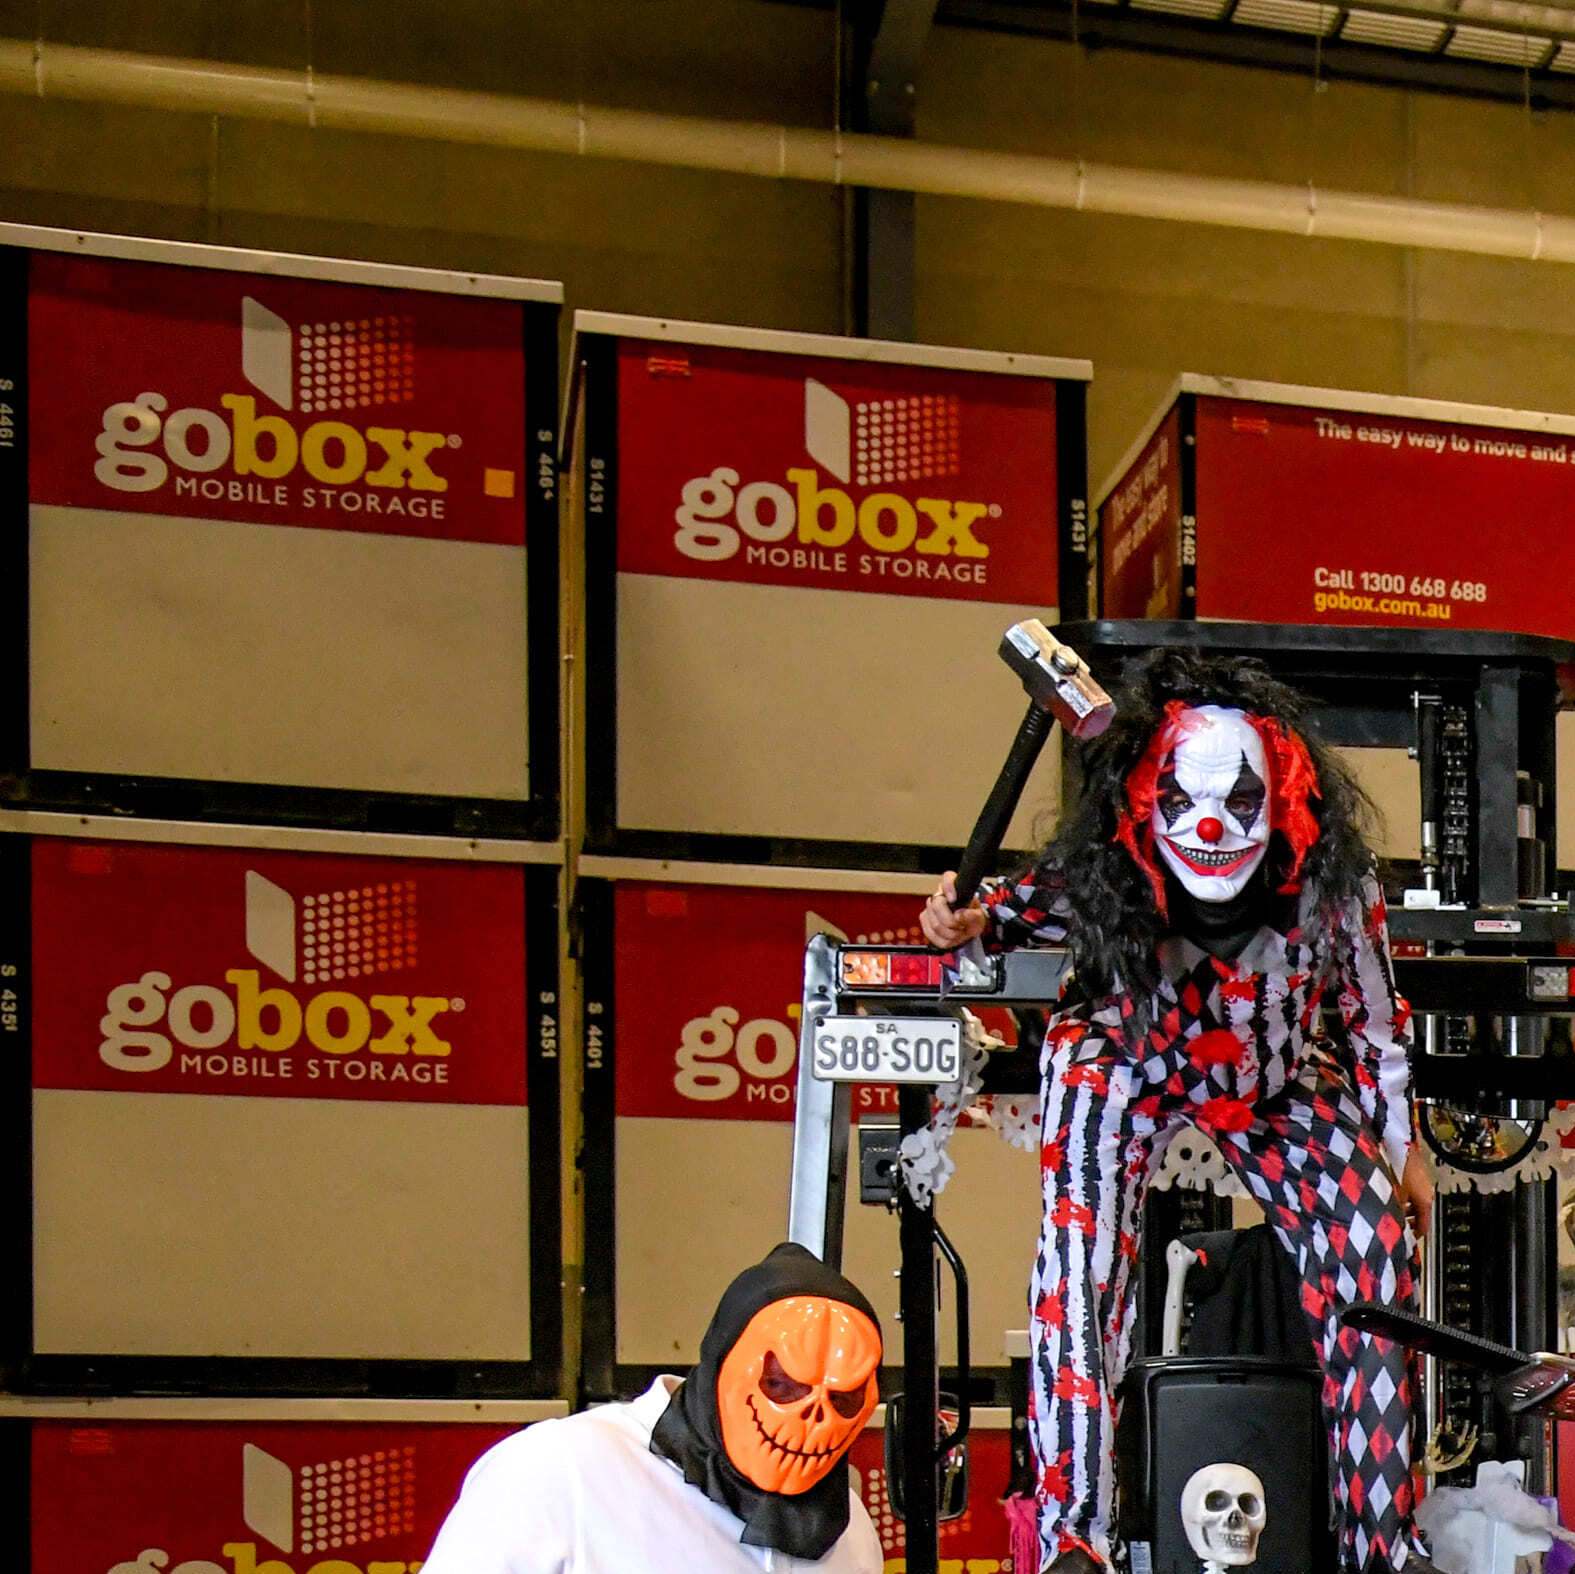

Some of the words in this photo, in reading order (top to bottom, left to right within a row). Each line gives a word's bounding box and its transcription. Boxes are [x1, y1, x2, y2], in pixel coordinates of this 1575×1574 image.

[94, 392, 448, 492] gobox
[1315, 418, 1352, 441] The
[1357, 425, 1403, 449] easy
[1406, 433, 1446, 454] way
[1451, 433, 1470, 454] to
[1474, 438, 1526, 460] move
[1531, 443, 1566, 464] and
[175, 477, 288, 506] MOBILE
[303, 488, 445, 520] STORAGE
[674, 467, 989, 561] gobox
[1070, 499, 1086, 552] S1431
[747, 547, 846, 572] MOBILE
[860, 556, 986, 583] STORAGE
[1315, 567, 1354, 589] Call
[1361, 572, 1405, 593] 1300
[1410, 577, 1445, 598] 668
[1450, 580, 1487, 602] 688
[1315, 591, 1450, 619] gobox.com.au
[99, 969, 452, 1073] gobox
[876, 1023, 898, 1034] SA
[180, 1053, 292, 1079] MOBILE
[306, 1058, 449, 1085] STORAGE
[817, 1035, 955, 1073] S88-SOG
